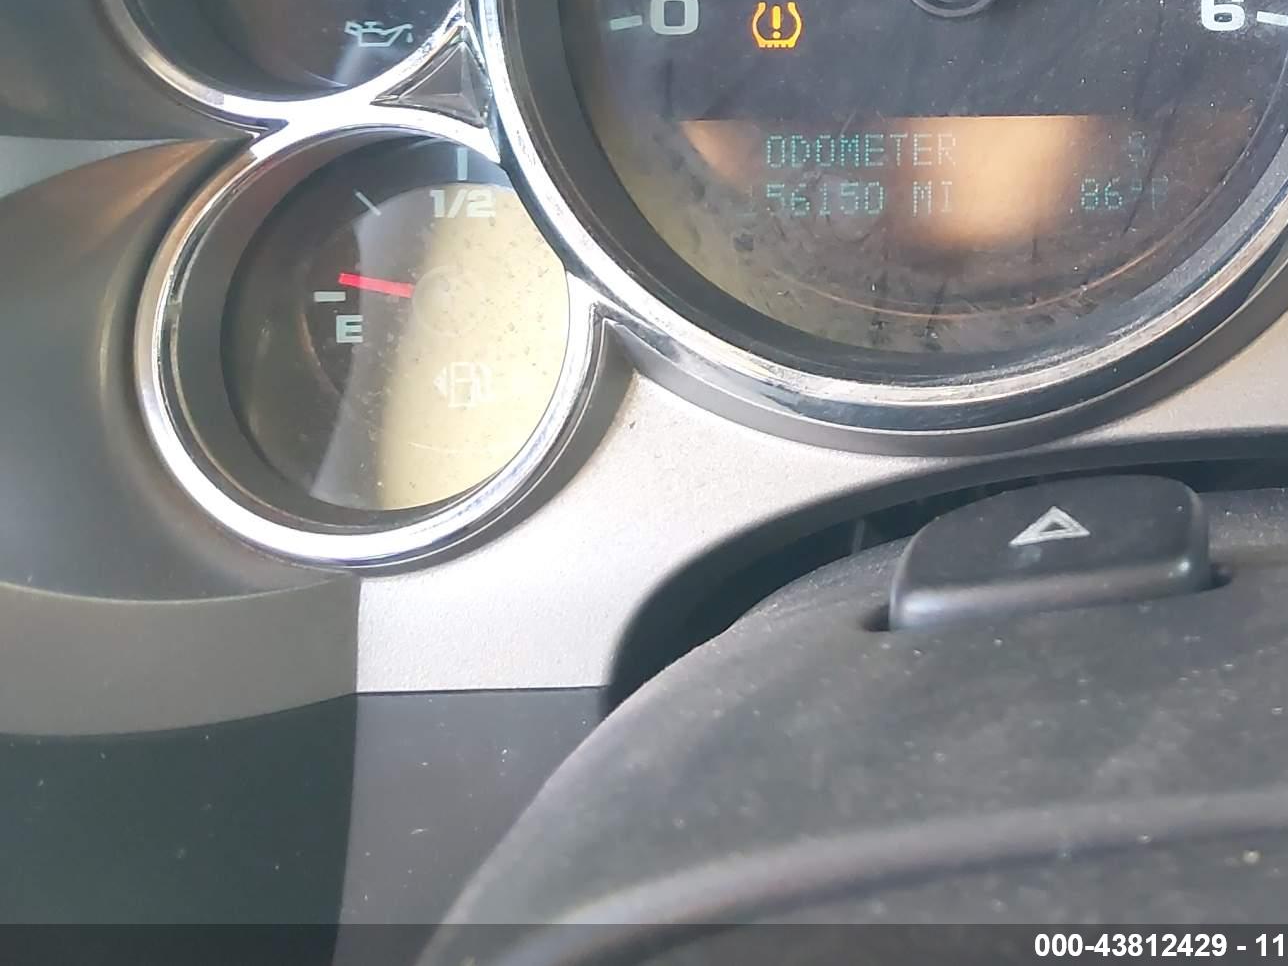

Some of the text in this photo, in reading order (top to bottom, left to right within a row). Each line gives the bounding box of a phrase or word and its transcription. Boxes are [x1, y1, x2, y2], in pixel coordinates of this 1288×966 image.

[766, 133, 957, 169] ODOMETER
[429, 188, 497, 219] 1/2
[765, 180, 954, 218] 56150 MI
[335, 314, 365, 344] E
